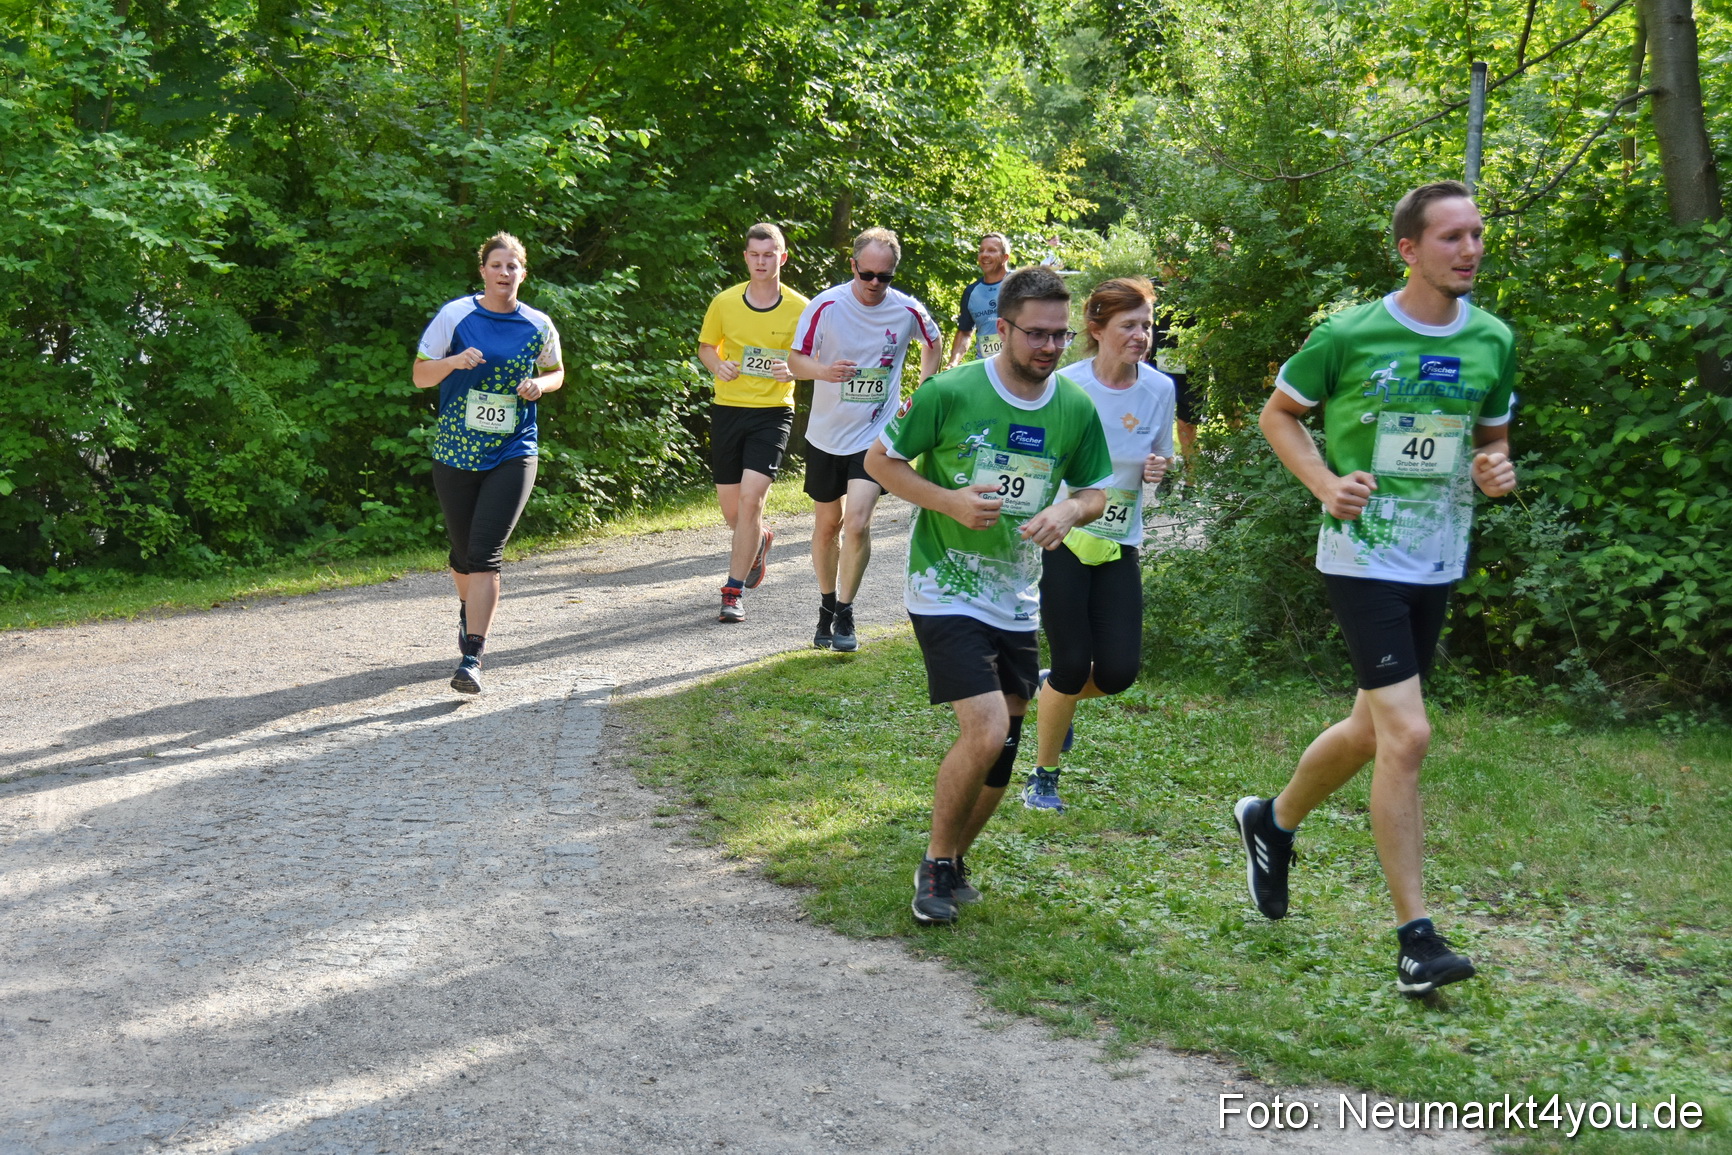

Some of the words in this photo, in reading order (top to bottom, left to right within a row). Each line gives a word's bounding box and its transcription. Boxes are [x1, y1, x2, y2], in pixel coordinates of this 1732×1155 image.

[746, 356, 775, 370] 220
[1427, 365, 1457, 374] Fischer
[848, 380, 883, 393] 1778
[476, 406, 506, 422] 203
[1015, 434, 1042, 444] Fischer
[1402, 437, 1435, 460] 40
[1396, 460, 1420, 468] Gruber
[1420, 460, 1438, 468] Peter
[996, 474, 1024, 498] 39
[1004, 498, 1030, 506] Benjamin
[1097, 505, 1128, 524] 54
